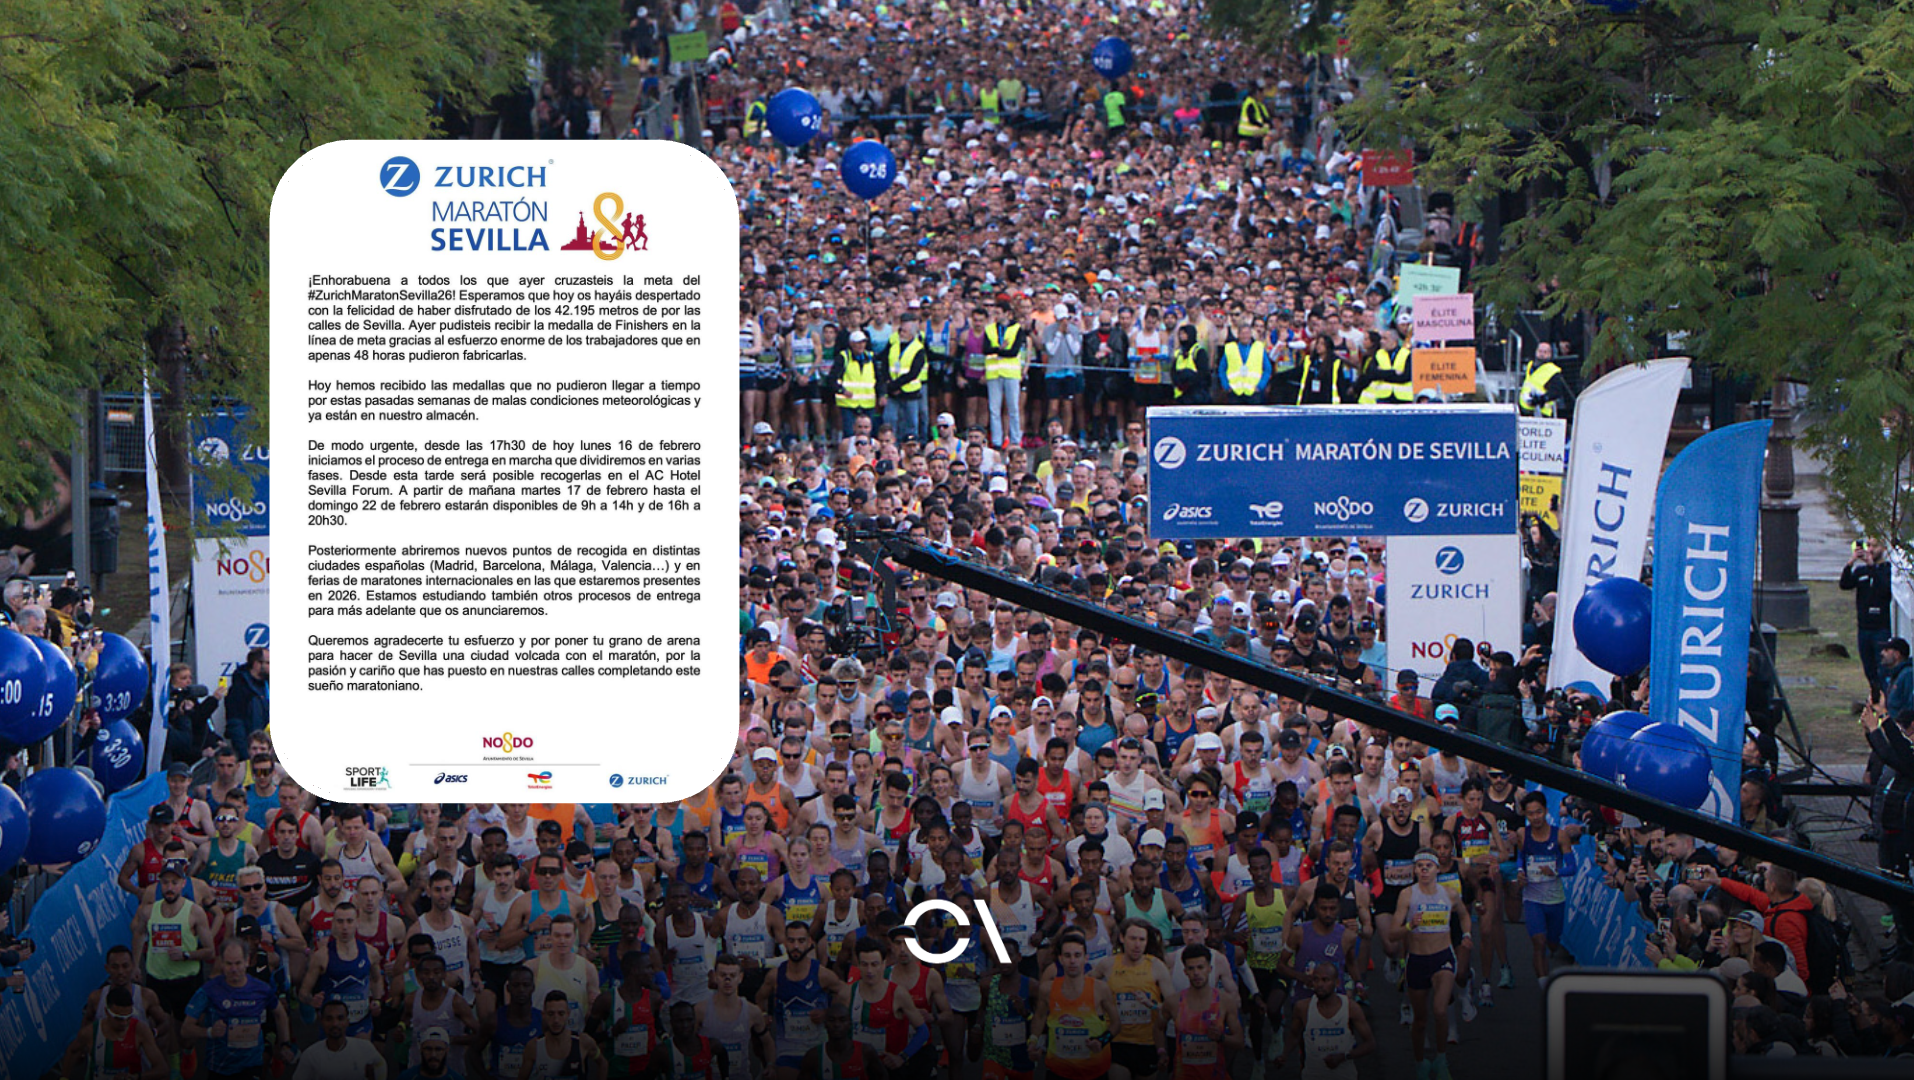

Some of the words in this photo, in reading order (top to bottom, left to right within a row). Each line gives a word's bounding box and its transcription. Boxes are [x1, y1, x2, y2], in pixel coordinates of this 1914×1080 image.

[1417, 319, 1473, 328] MASCULINA
[1419, 372, 1468, 381] FEMENINA
[1519, 427, 1553, 438] ORLD
[1196, 443, 1284, 462] ZURICH
[1295, 438, 1393, 461] MARATÓN
[1397, 442, 1425, 460] DE
[1430, 441, 1510, 461] SEVILLA
[1521, 440, 1547, 449] LITE
[1521, 452, 1563, 462] CULINA
[1521, 484, 1544, 494] RLD
[1520, 497, 1538, 506] ITE
[1436, 502, 1504, 517] ZURICH
[1586, 462, 1633, 582] RICH
[1411, 583, 1489, 599] ZURICH
[1677, 521, 1730, 745] ZURICH
[104, 690, 131, 712] 3:30
[104, 738, 132, 768] 3:30
